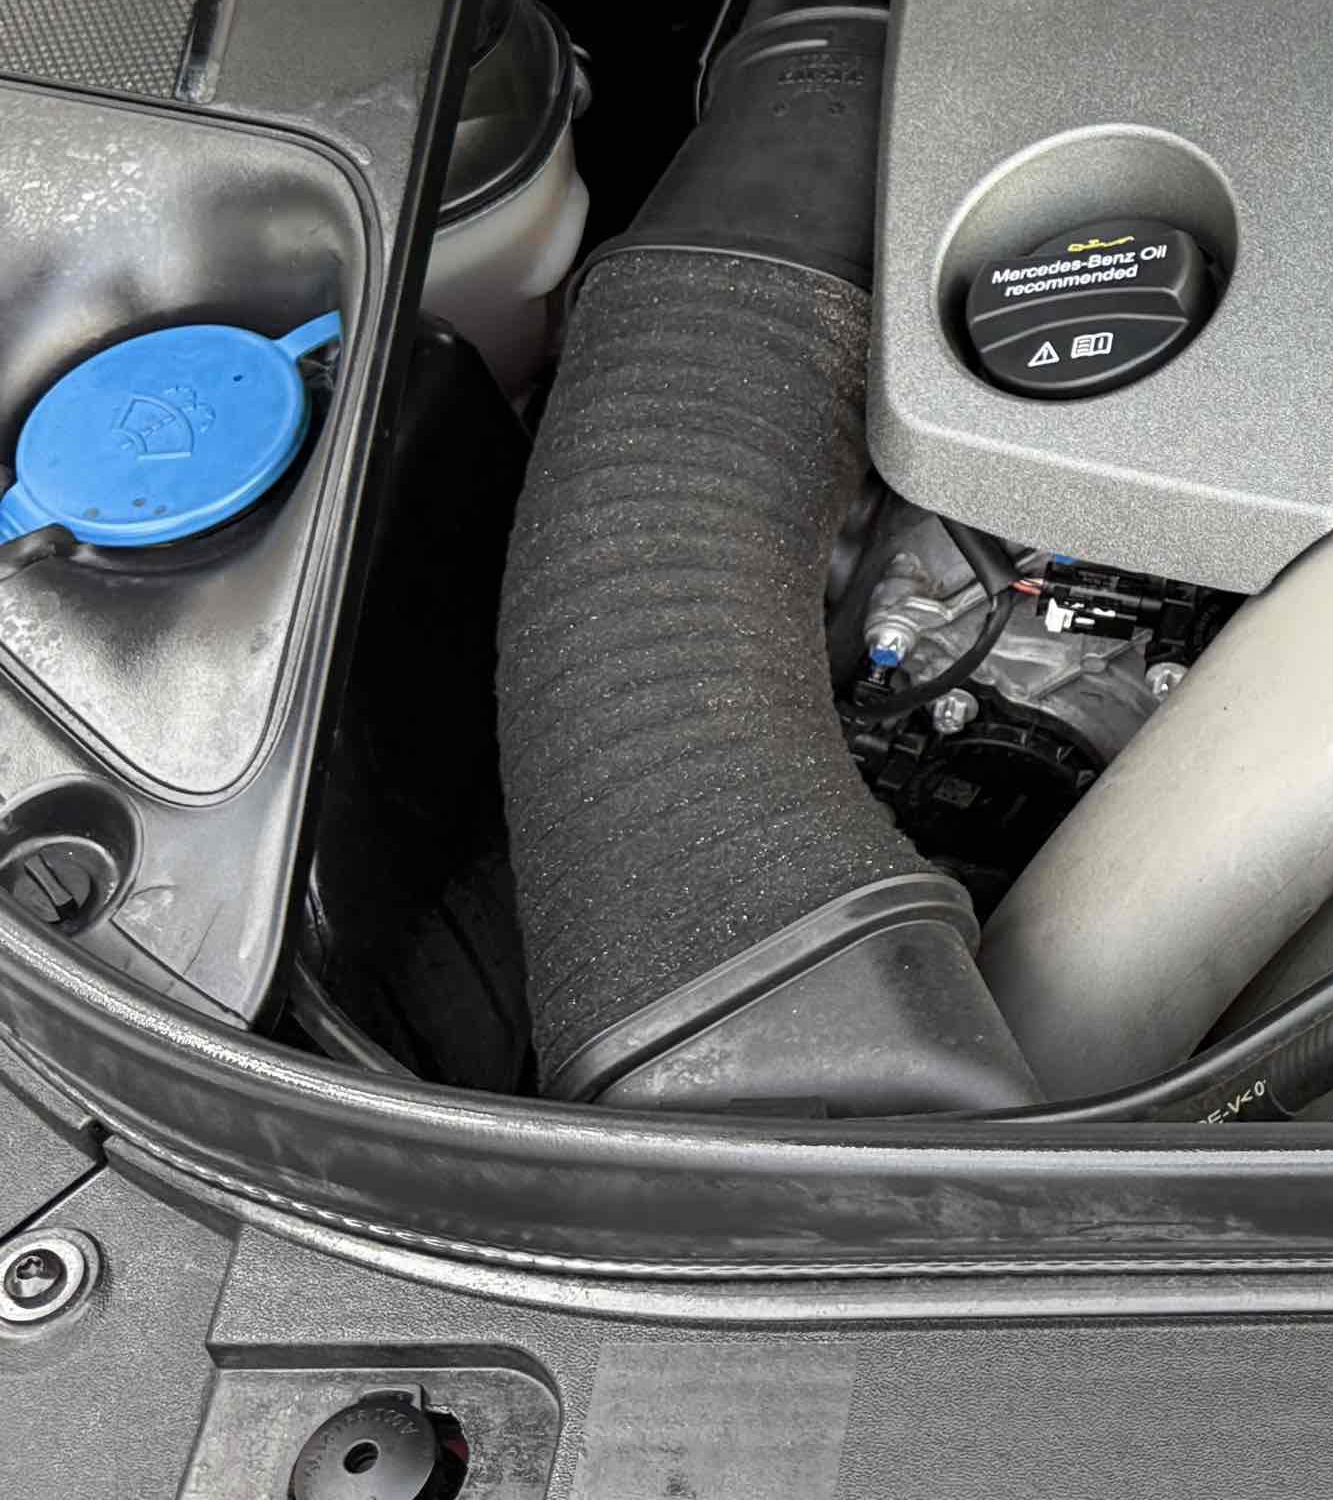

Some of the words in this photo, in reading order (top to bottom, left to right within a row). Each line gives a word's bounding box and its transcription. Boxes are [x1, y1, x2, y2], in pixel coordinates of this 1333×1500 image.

[992, 251, 1136, 285] Mercedes-Benz
[1140, 244, 1168, 261] Oil
[1004, 264, 1139, 298] recommended
